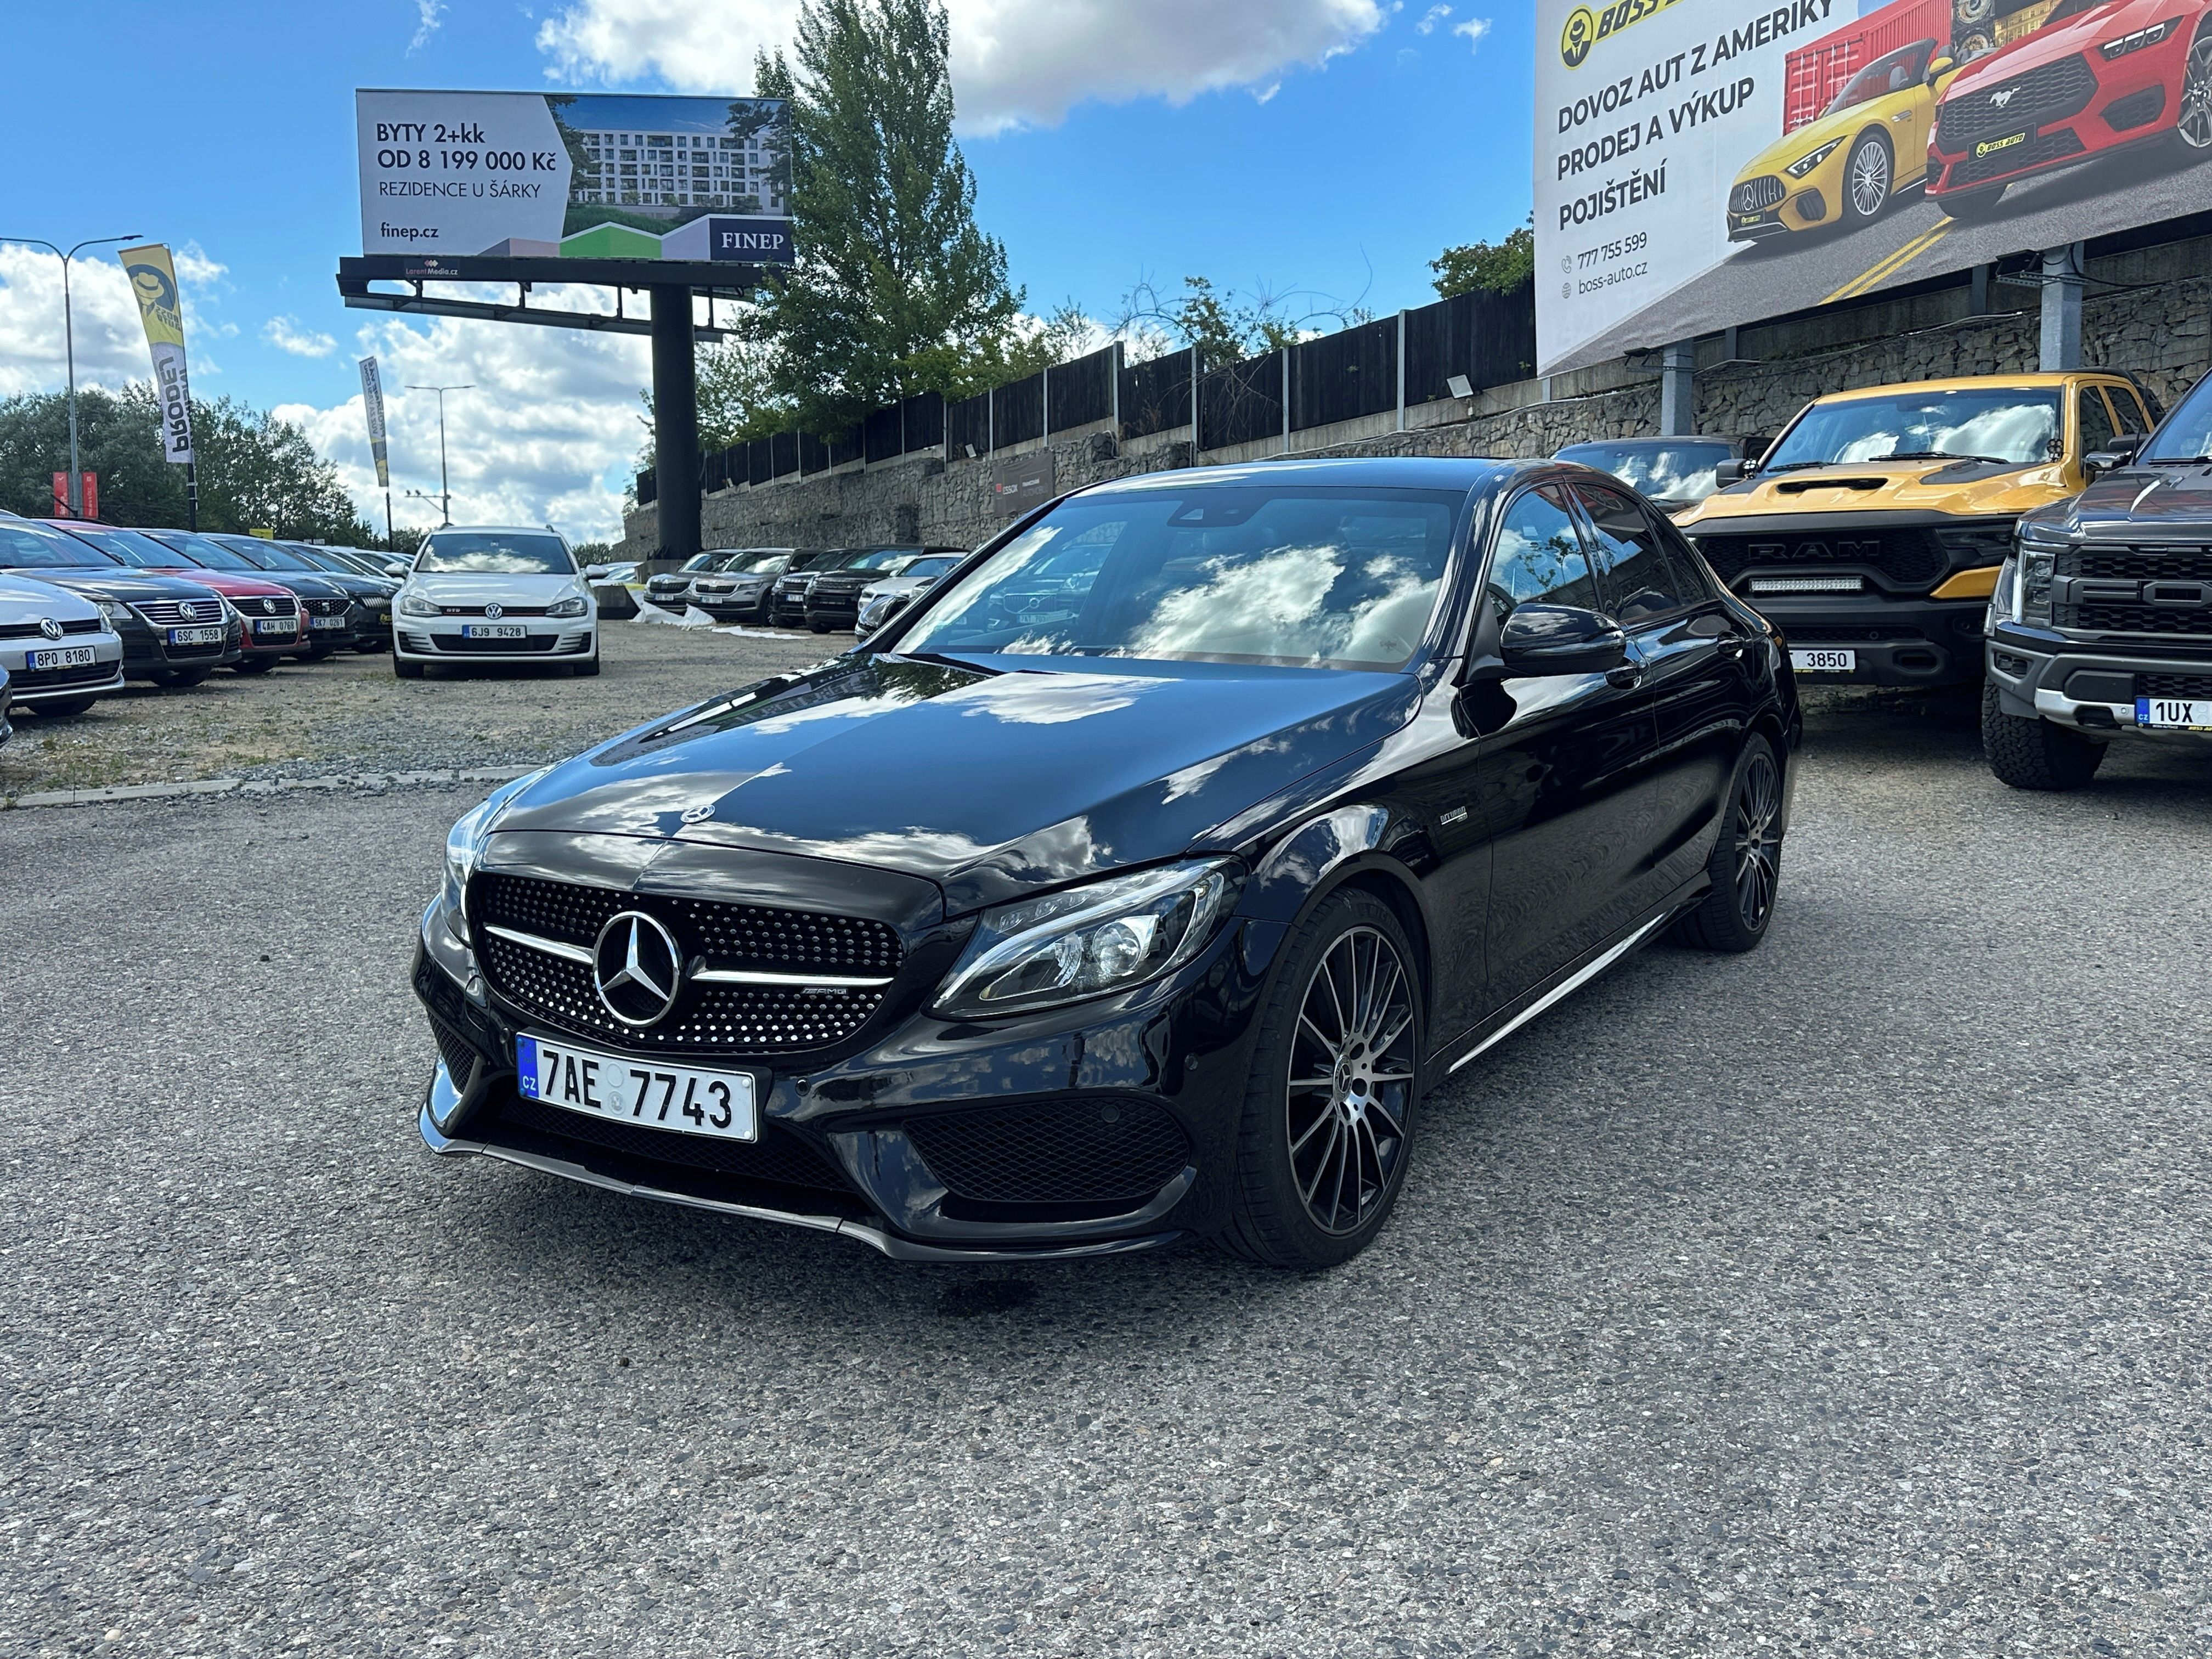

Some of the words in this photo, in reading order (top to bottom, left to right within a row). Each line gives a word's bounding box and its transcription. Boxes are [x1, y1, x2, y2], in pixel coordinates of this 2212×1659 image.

[1559, 76, 1633, 134] DOVOZ
[1638, 52, 1685, 99] AUT
[1691, 43, 1706, 76] Z
[1711, 0, 1834, 66] AMERIKY
[377, 123, 426, 142] BYTY
[433, 123, 486, 143] 2+kk
[1558, 122, 1640, 181] PRODEJ
[1646, 115, 1664, 145] A
[1668, 77, 1755, 134] VÝKUP
[1987, 140, 2004, 151] BOSS
[377, 149, 411, 168] OD
[419, 150, 431, 168] 8
[441, 151, 478, 169] 199
[486, 151, 525, 170] 000
[533, 152, 556, 171] Kč
[380, 182, 467, 196] REZIDENCE
[473, 183, 483, 197] U
[490, 179, 541, 198] ŠÁRKY
[1560, 157, 1668, 231] POJIŠTĚNÍ
[381, 222, 439, 241] finep.cz
[721, 232, 784, 250] FINEP
[1578, 248, 1598, 269] 777
[1601, 240, 1622, 262] 755
[1624, 232, 1647, 253] 599
[1579, 262, 1647, 295] boss-auto.cz
[1748, 540, 1880, 559] RAM
[177, 631, 193, 641] 6SC
[200, 629, 218, 640] 1558
[472, 628, 489, 636] 6J9
[497, 628, 521, 636] 9428
[37, 652, 58, 666] 8P0
[65, 649, 91, 663] 8180
[1807, 652, 1847, 667] 3850
[2156, 702, 2193, 723] 1UX
[522, 1075, 537, 1091] CZ
[543, 1049, 601, 1109] 7AE
[630, 1069, 731, 1128] 7743
